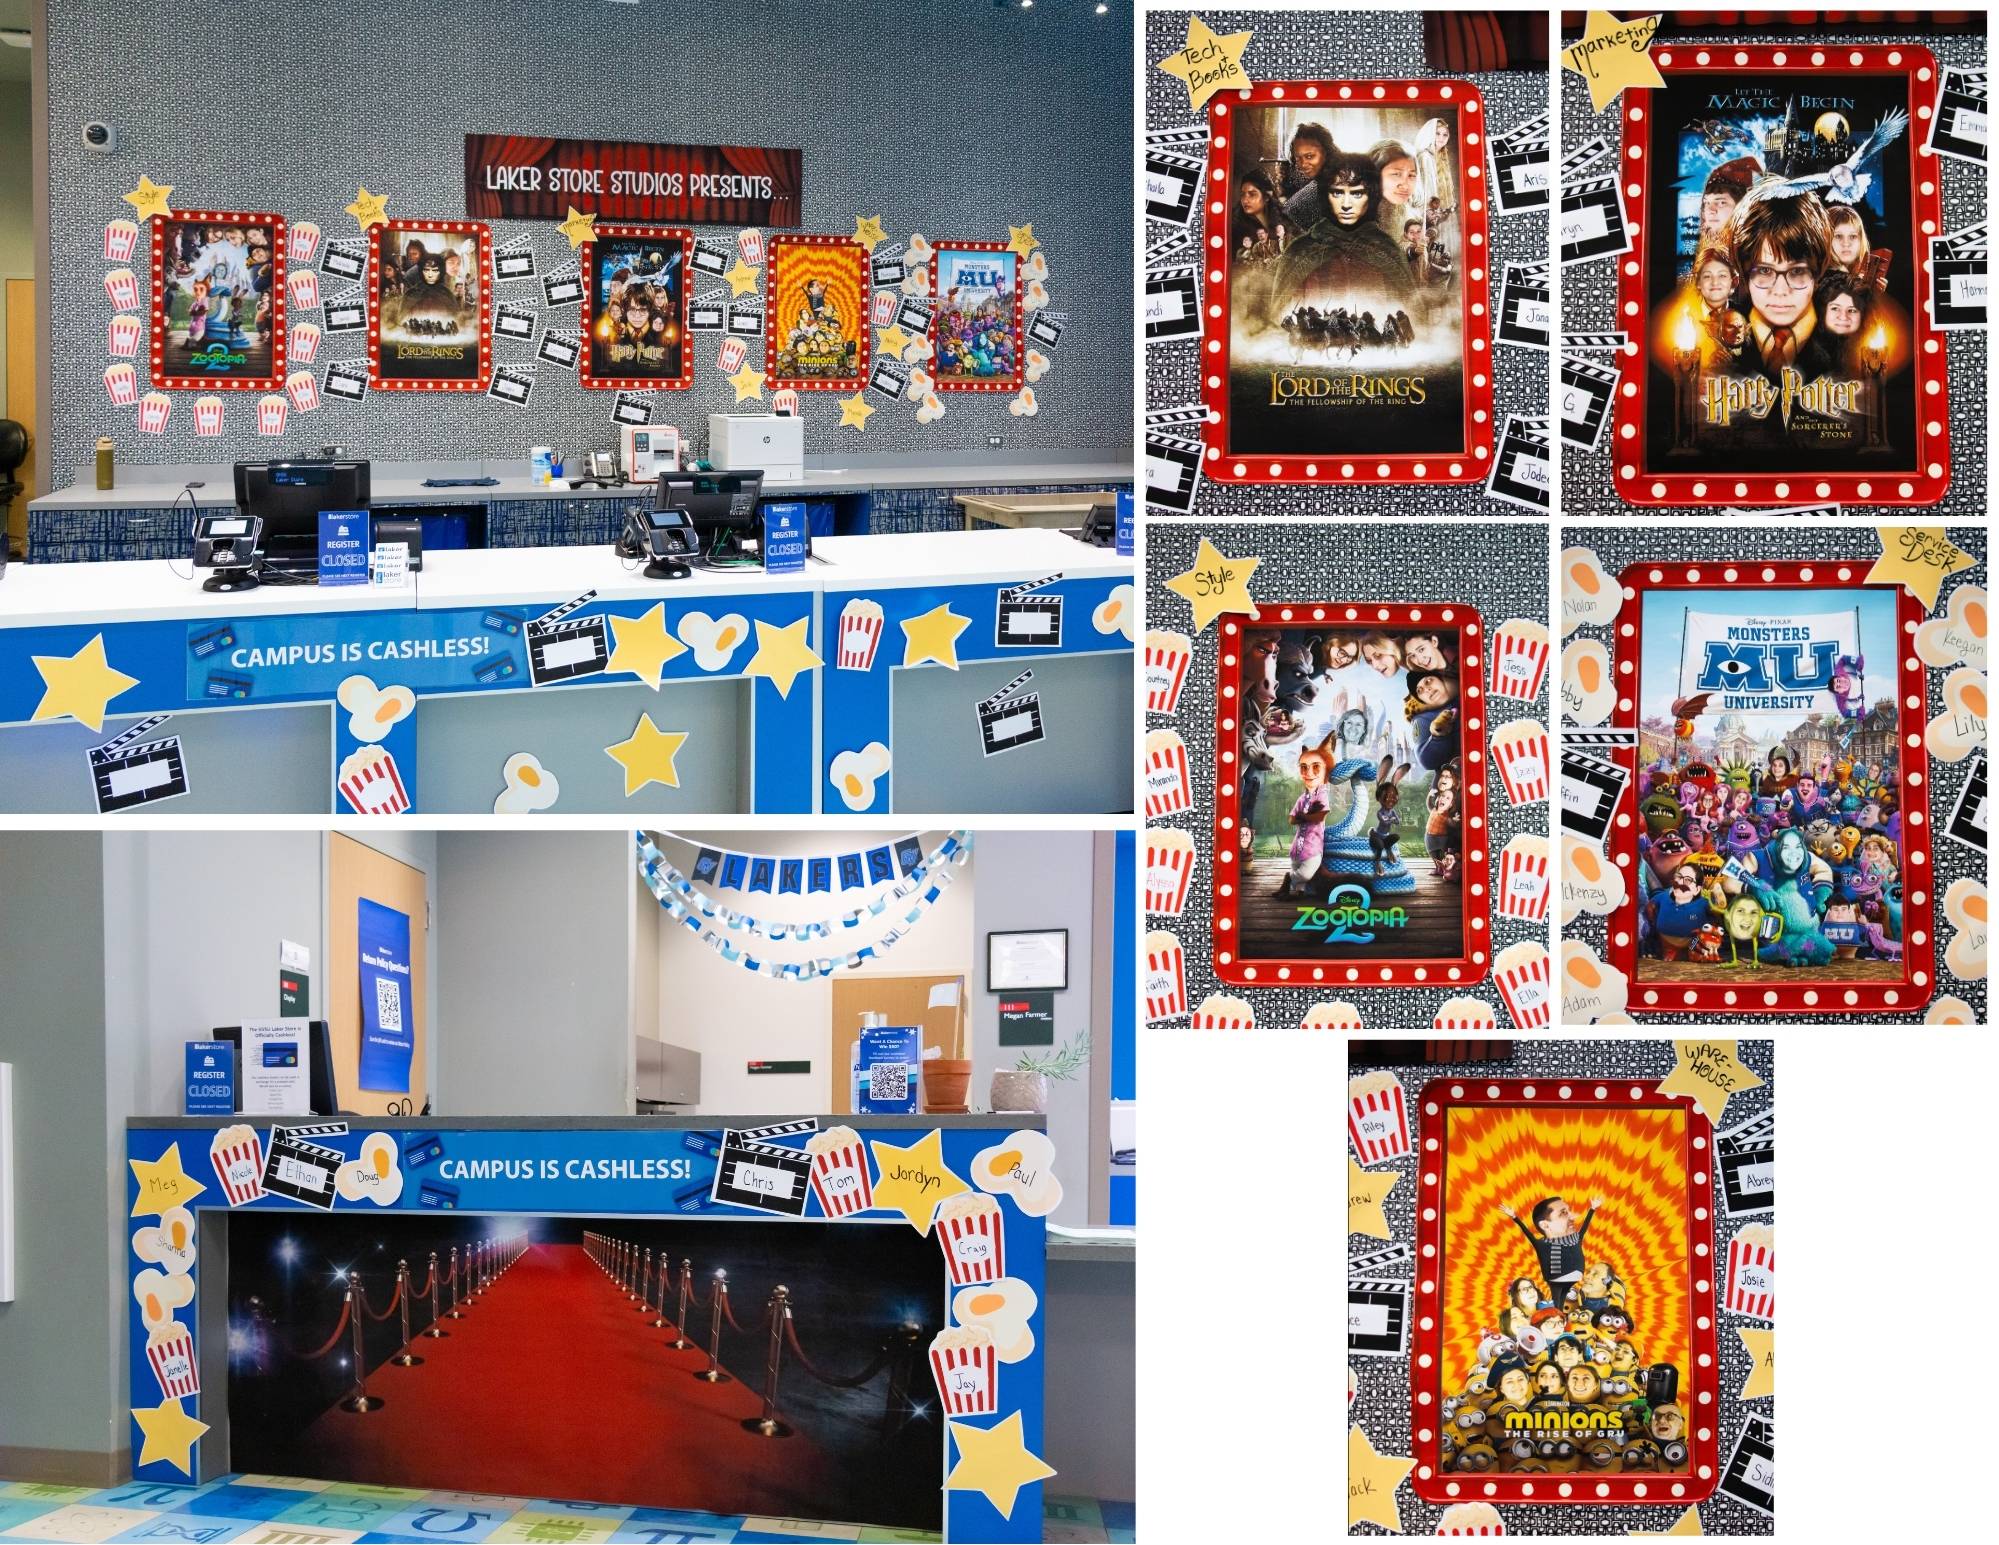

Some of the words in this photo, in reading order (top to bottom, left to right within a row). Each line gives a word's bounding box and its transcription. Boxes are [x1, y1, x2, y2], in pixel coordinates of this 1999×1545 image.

[1181, 39, 1224, 65] Tech
[1189, 62, 1239, 93] Books
[1706, 95, 1780, 109] MAGIC
[1800, 95, 1855, 109] BEGIN
[486, 165, 541, 191] LAKER
[549, 168, 604, 194] STORE
[611, 170, 683, 197] STUDIOS
[690, 173, 789, 200] PRESENTS...
[1524, 173, 1548, 188] Aris
[956, 270, 998, 287] MU
[190, 353, 247, 364] ZOOTOPIA
[397, 345, 423, 360] LORD
[431, 347, 463, 359] RINGS
[609, 343, 637, 362] Harry
[637, 341, 665, 364] Potter
[1268, 372, 1331, 405] LORD
[1331, 386, 1350, 395] THE
[1333, 379, 1348, 387] OF
[1350, 374, 1426, 405] RINGS
[1701, 374, 1780, 426] Harry
[1781, 365, 1864, 432] Potter
[1791, 422, 1847, 430] SORCERER'S
[1820, 431, 1852, 439] STONE
[772, 531, 798, 539] REGISTER
[1899, 527, 1959, 559] Service
[327, 541, 360, 549] REGISTER
[767, 543, 803, 556] CLOSED
[321, 553, 365, 567] CLOSED
[1902, 542, 1957, 573] Desk
[1194, 566, 1235, 596] Style
[1564, 599, 1597, 616] Nolan
[1728, 627, 1810, 641] MONSTERS
[1943, 630, 1984, 657] Keegan
[231, 644, 335, 669] CAMPUS
[341, 643, 362, 662] IS
[368, 636, 490, 660] CASHLESS!
[1504, 659, 1526, 676] Jess
[1697, 640, 1839, 692] MU
[1724, 695, 1814, 709] UNIVERSITY
[1954, 714, 1987, 741] Lily
[1514, 766, 1536, 779] Izzy
[726, 851, 890, 888] LAKERS
[1514, 878, 1535, 892] Leah
[1291, 906, 1409, 930] ZOOTOPIA
[1518, 987, 1540, 1004] Ella
[1562, 996, 1601, 1016] Adam
[1684, 1043, 1733, 1068] WARE-
[1690, 1060, 1736, 1093] HOUSE
[188, 1085, 231, 1098] CLOSED
[1362, 1120, 1386, 1136] Riley
[232, 1167, 254, 1182] Nicole
[285, 1161, 318, 1185] Ethan
[356, 1170, 380, 1185] Doug
[439, 1159, 533, 1179] CAMPUS
[540, 1159, 560, 1179] IS
[564, 1159, 691, 1179] CASHLESS!
[1008, 1162, 1036, 1188] Paul
[149, 1177, 178, 1195] Meg
[743, 1169, 774, 1191] Chris
[823, 1174, 855, 1191] Tom
[889, 1164, 941, 1194] Jordyn
[958, 1241, 988, 1257] Craig
[1741, 1269, 1765, 1288] Josie
[164, 1362, 189, 1378] Janelle
[954, 1373, 977, 1393] Jay
[1505, 1411, 1624, 1429] minions
[1504, 1430, 1531, 1438] THE
[1537, 1430, 1570, 1438] RISE
[1575, 1430, 1593, 1438] OF
[1597, 1430, 1625, 1438] GRU
